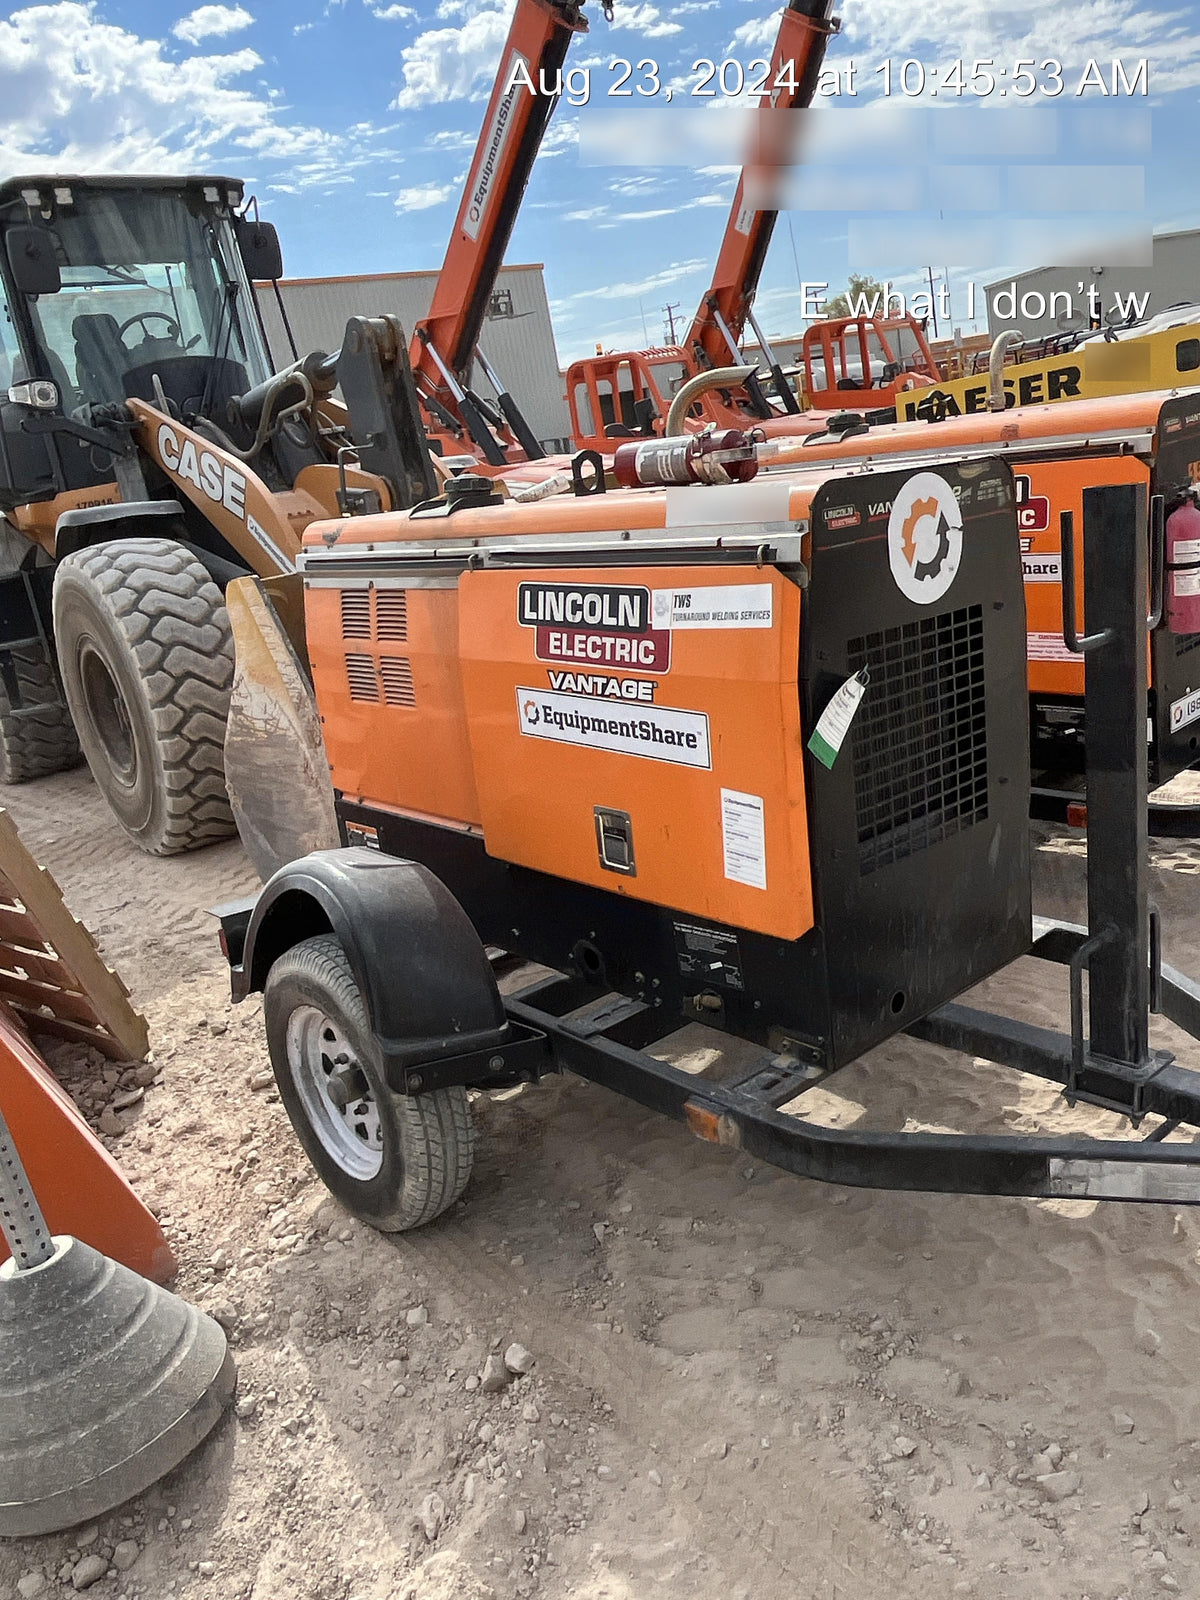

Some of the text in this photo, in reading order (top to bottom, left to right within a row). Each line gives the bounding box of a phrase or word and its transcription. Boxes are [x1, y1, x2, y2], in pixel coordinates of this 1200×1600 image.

[157, 423, 247, 520] CASE
[523, 589, 641, 628] LINCOLN
[672, 610, 771, 622] TURNAROUND WELDING SERVICES
[673, 594, 692, 609] TWS
[548, 632, 655, 665] ELECTRIC
[548, 671, 653, 701] VANTAGE
[541, 704, 699, 750] EquipmentShare
